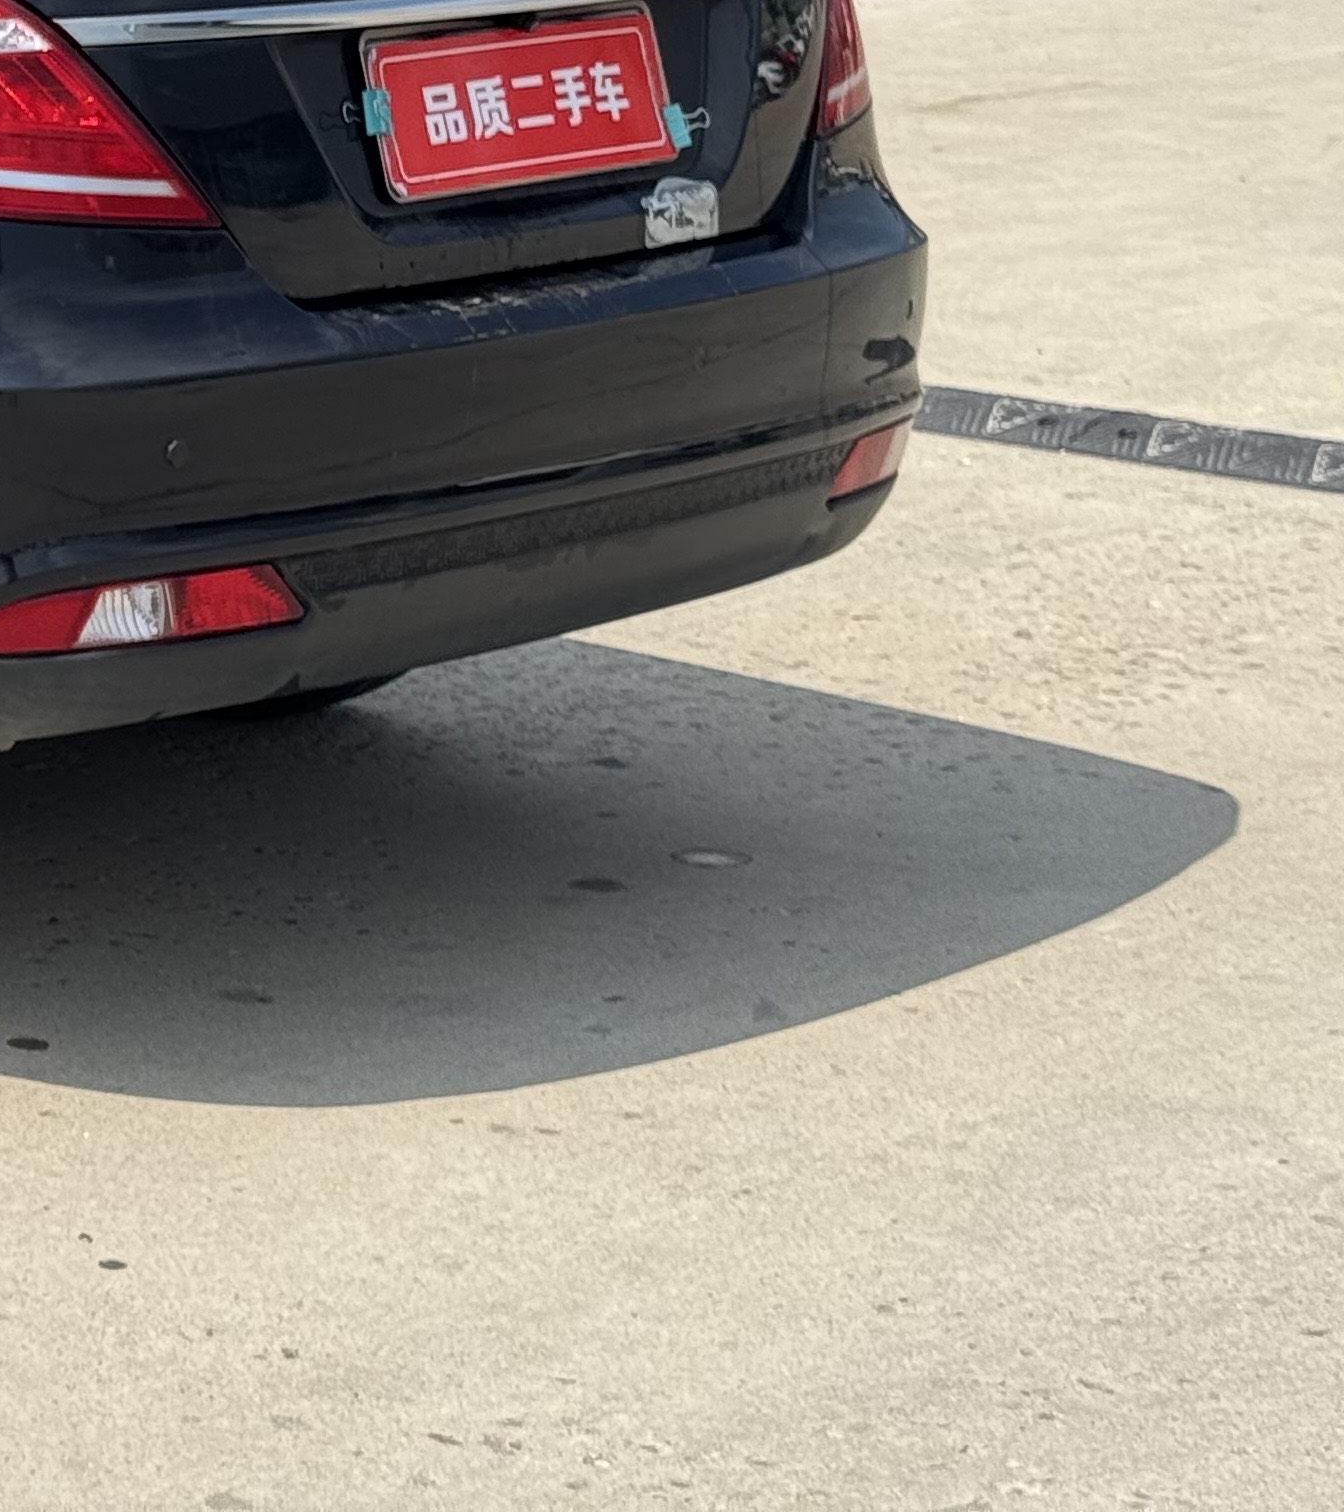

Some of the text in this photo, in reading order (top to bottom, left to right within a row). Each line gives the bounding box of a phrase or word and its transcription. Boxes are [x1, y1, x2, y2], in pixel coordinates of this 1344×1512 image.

[421, 61, 631, 146] 品质二手车
